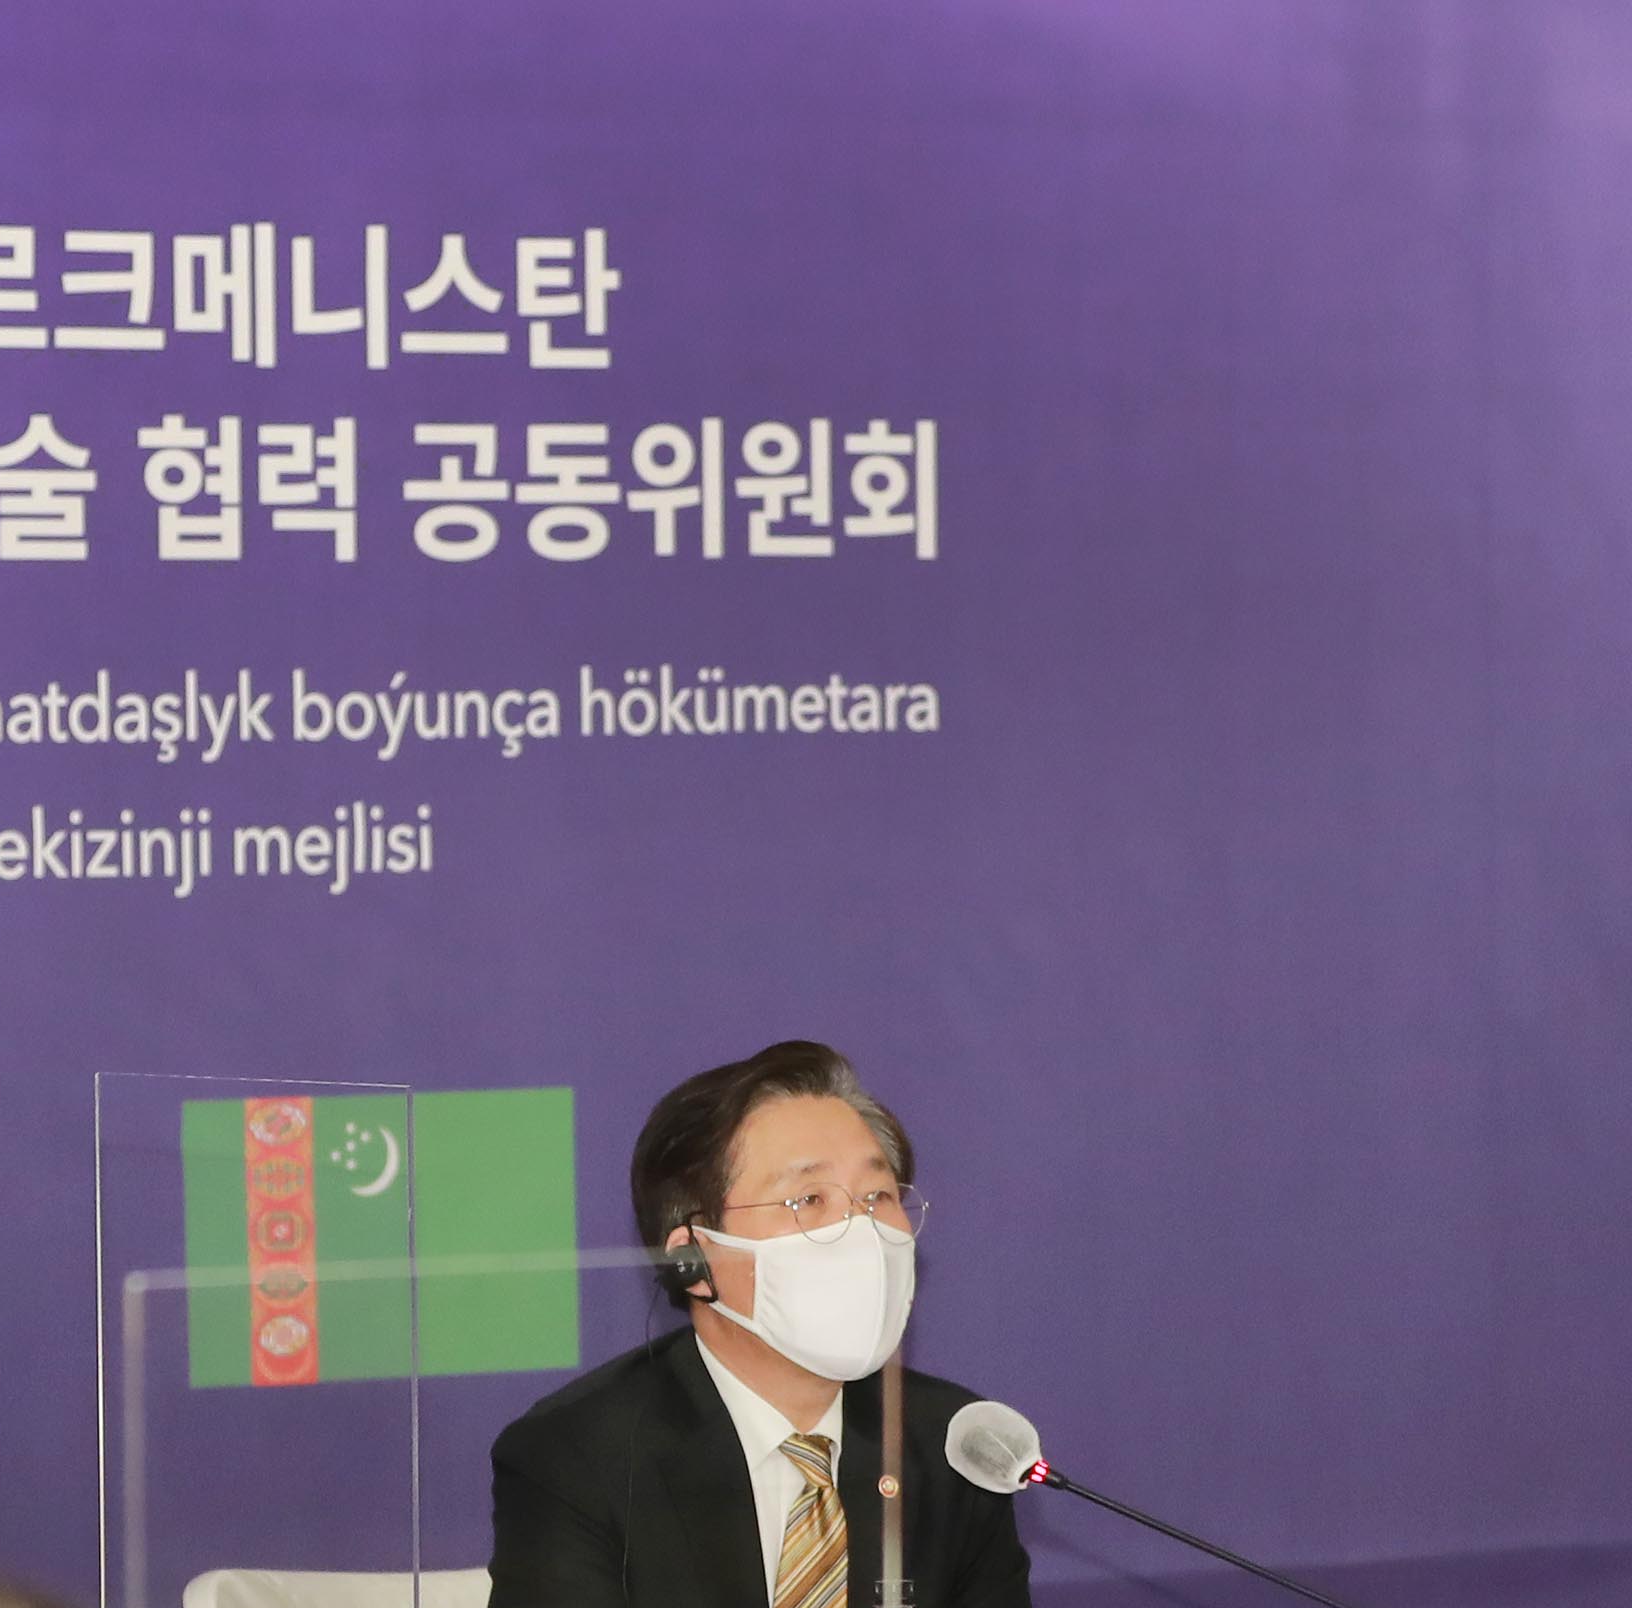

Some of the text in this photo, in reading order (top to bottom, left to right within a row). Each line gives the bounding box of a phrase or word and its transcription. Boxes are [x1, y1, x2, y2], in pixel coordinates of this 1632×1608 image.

[137, 414, 357, 563] 협력
[402, 417, 937, 562] 공동위원회
[292, 668, 560, 761] boýunça
[580, 664, 938, 740] hökümetara
[233, 801, 432, 895] mejlisi
